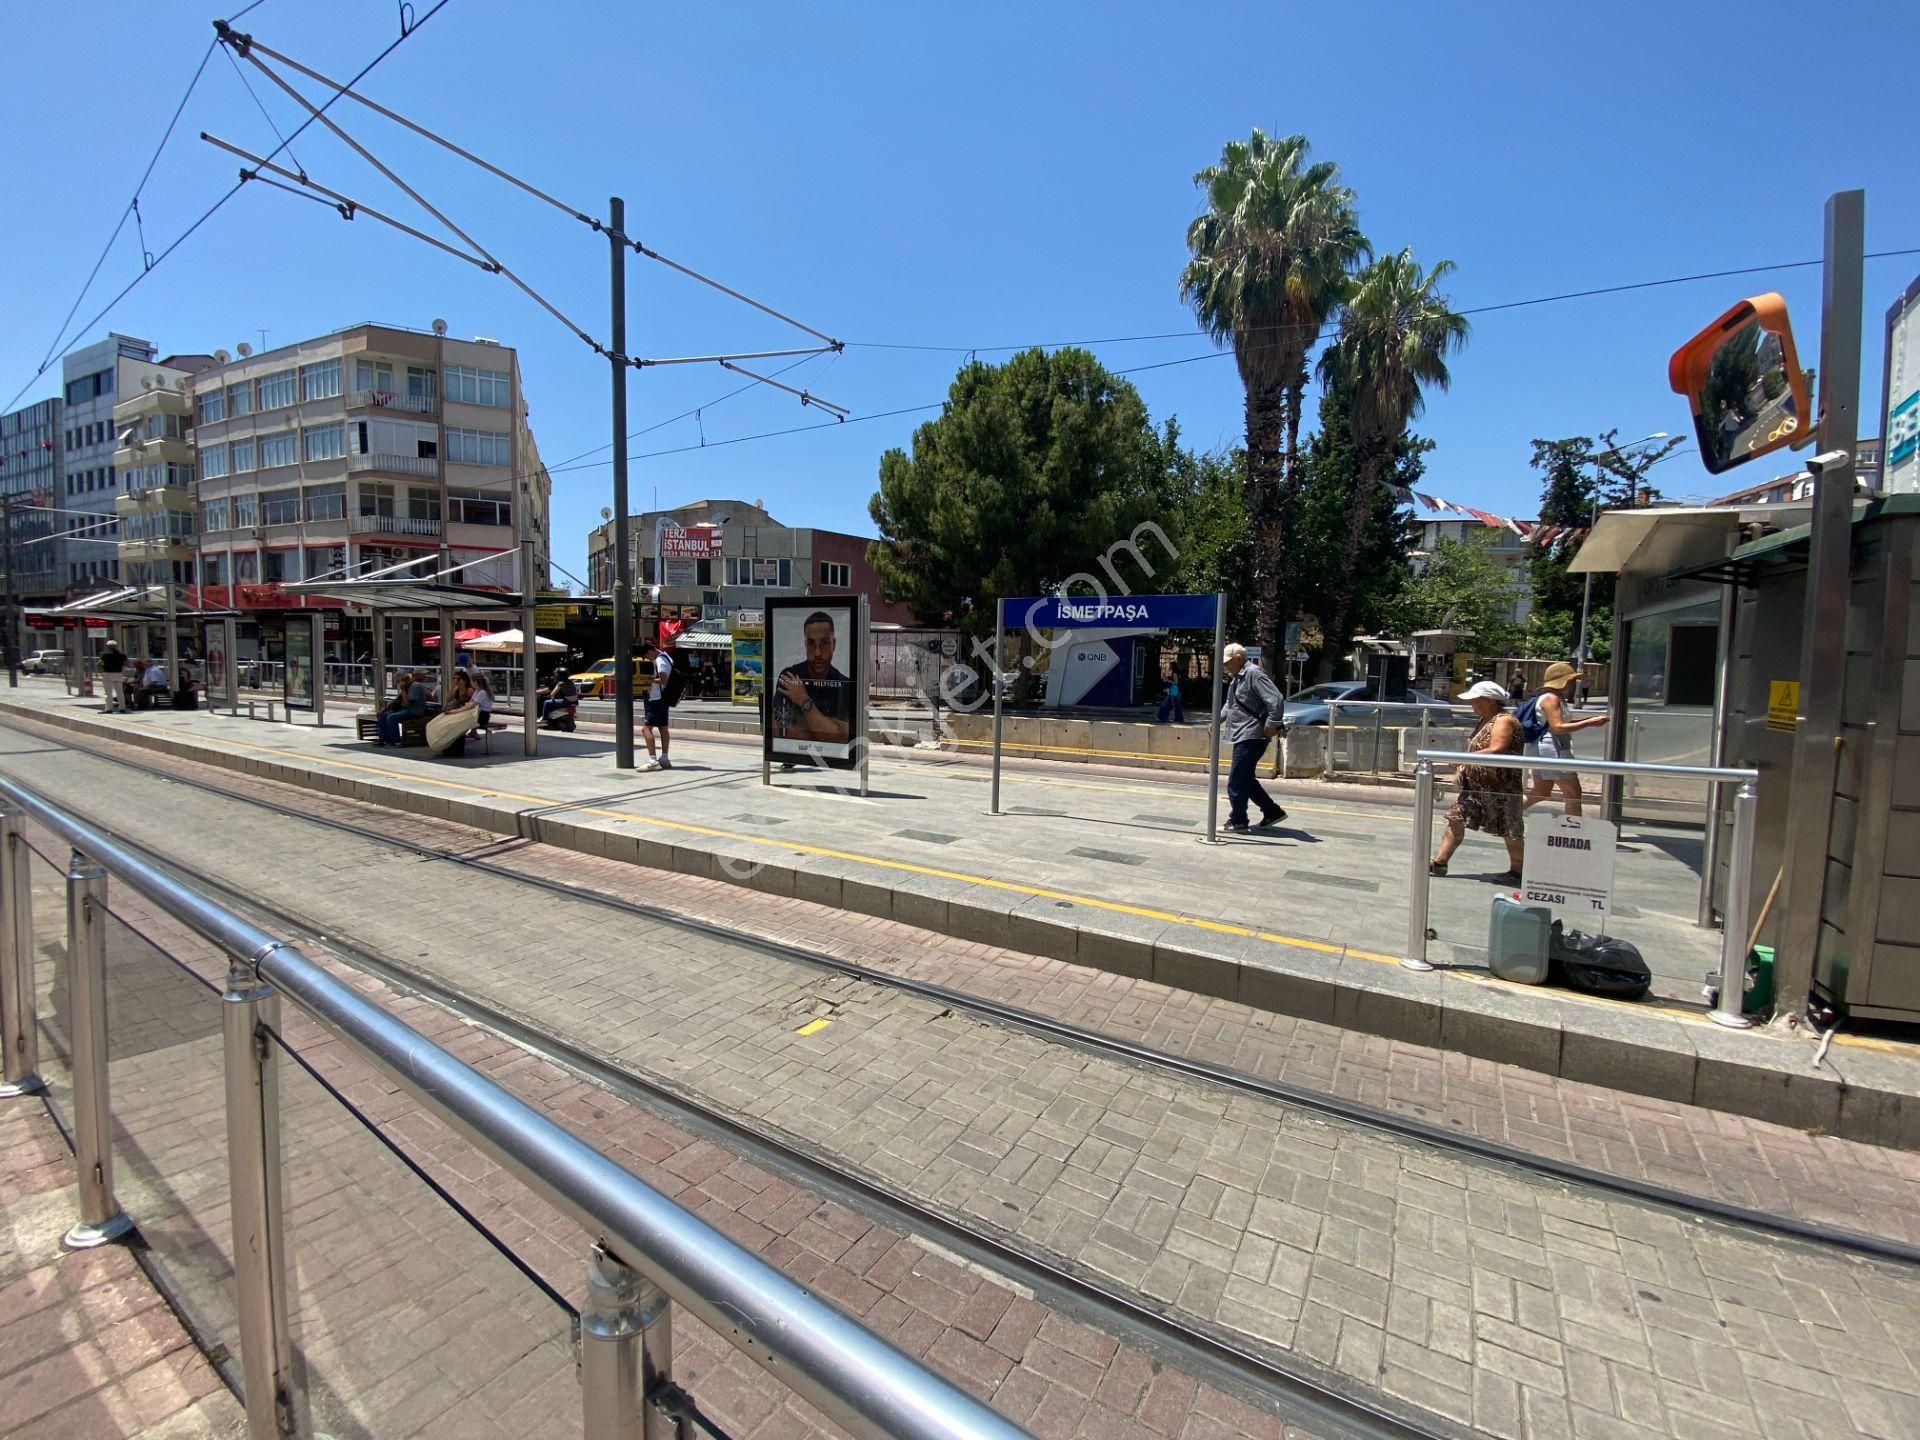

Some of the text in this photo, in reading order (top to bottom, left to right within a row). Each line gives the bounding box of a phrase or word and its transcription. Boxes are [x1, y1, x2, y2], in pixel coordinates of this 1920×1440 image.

[1057, 603, 1149, 622] İSMETPAŞA
[1087, 652, 1107, 662] QNB
[1547, 835, 1591, 851] BURADA
[1527, 891, 1566, 904] CEZASI
[1591, 899, 1605, 910] TL
